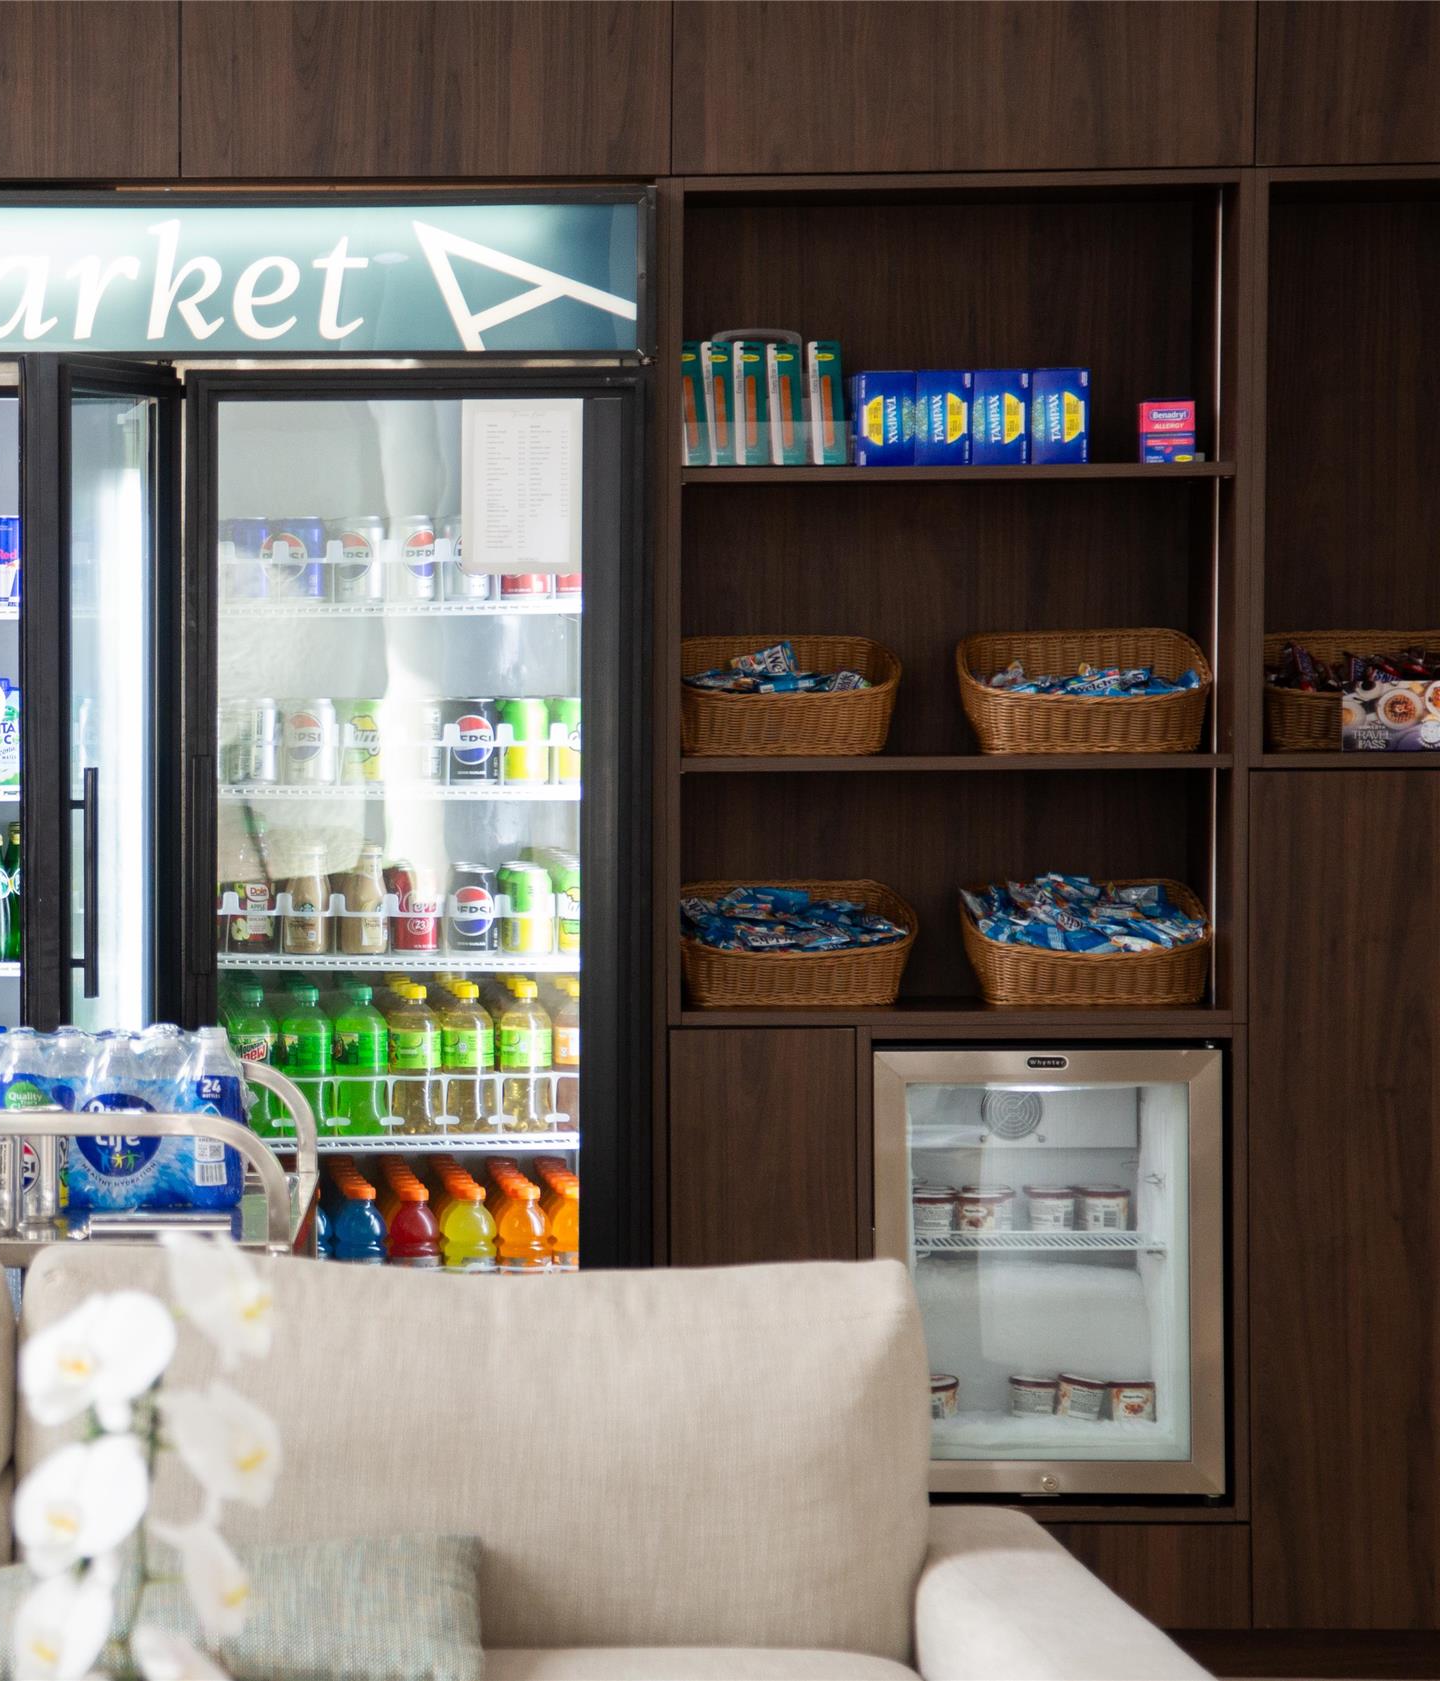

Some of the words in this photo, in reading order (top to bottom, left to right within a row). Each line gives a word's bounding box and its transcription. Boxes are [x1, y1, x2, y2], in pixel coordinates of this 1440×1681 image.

[886, 396, 898, 444] TAMPAX
[932, 394, 944, 442] TAMPAX
[989, 395, 1001, 443] TAMPAX
[1048, 394, 1061, 442] TAMPAX
[1152, 411, 1187, 419] Benadryl
[1352, 730, 1392, 740] TRAVEL
[1358, 740, 1386, 749] PASS
[250, 887, 267, 896] Dole
[202, 1079, 221, 1093] 24
[9, 1091, 42, 1101] Quality
